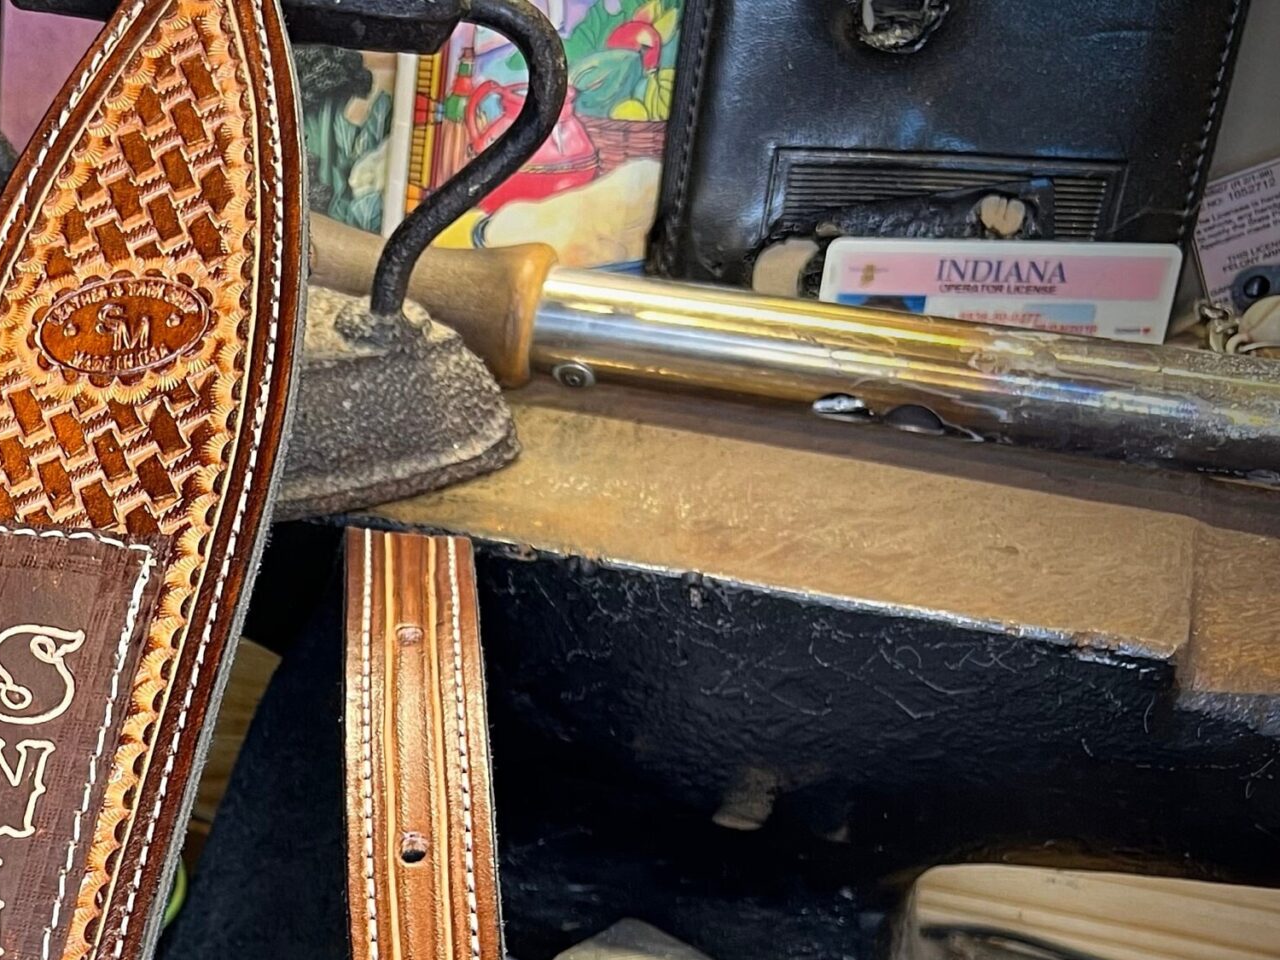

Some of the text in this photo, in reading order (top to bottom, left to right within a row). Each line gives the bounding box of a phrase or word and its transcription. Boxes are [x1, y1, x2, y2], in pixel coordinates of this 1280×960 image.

[937, 258, 1067, 284] INDIANA
[939, 284, 1057, 296] OPERATOR LICENSE
